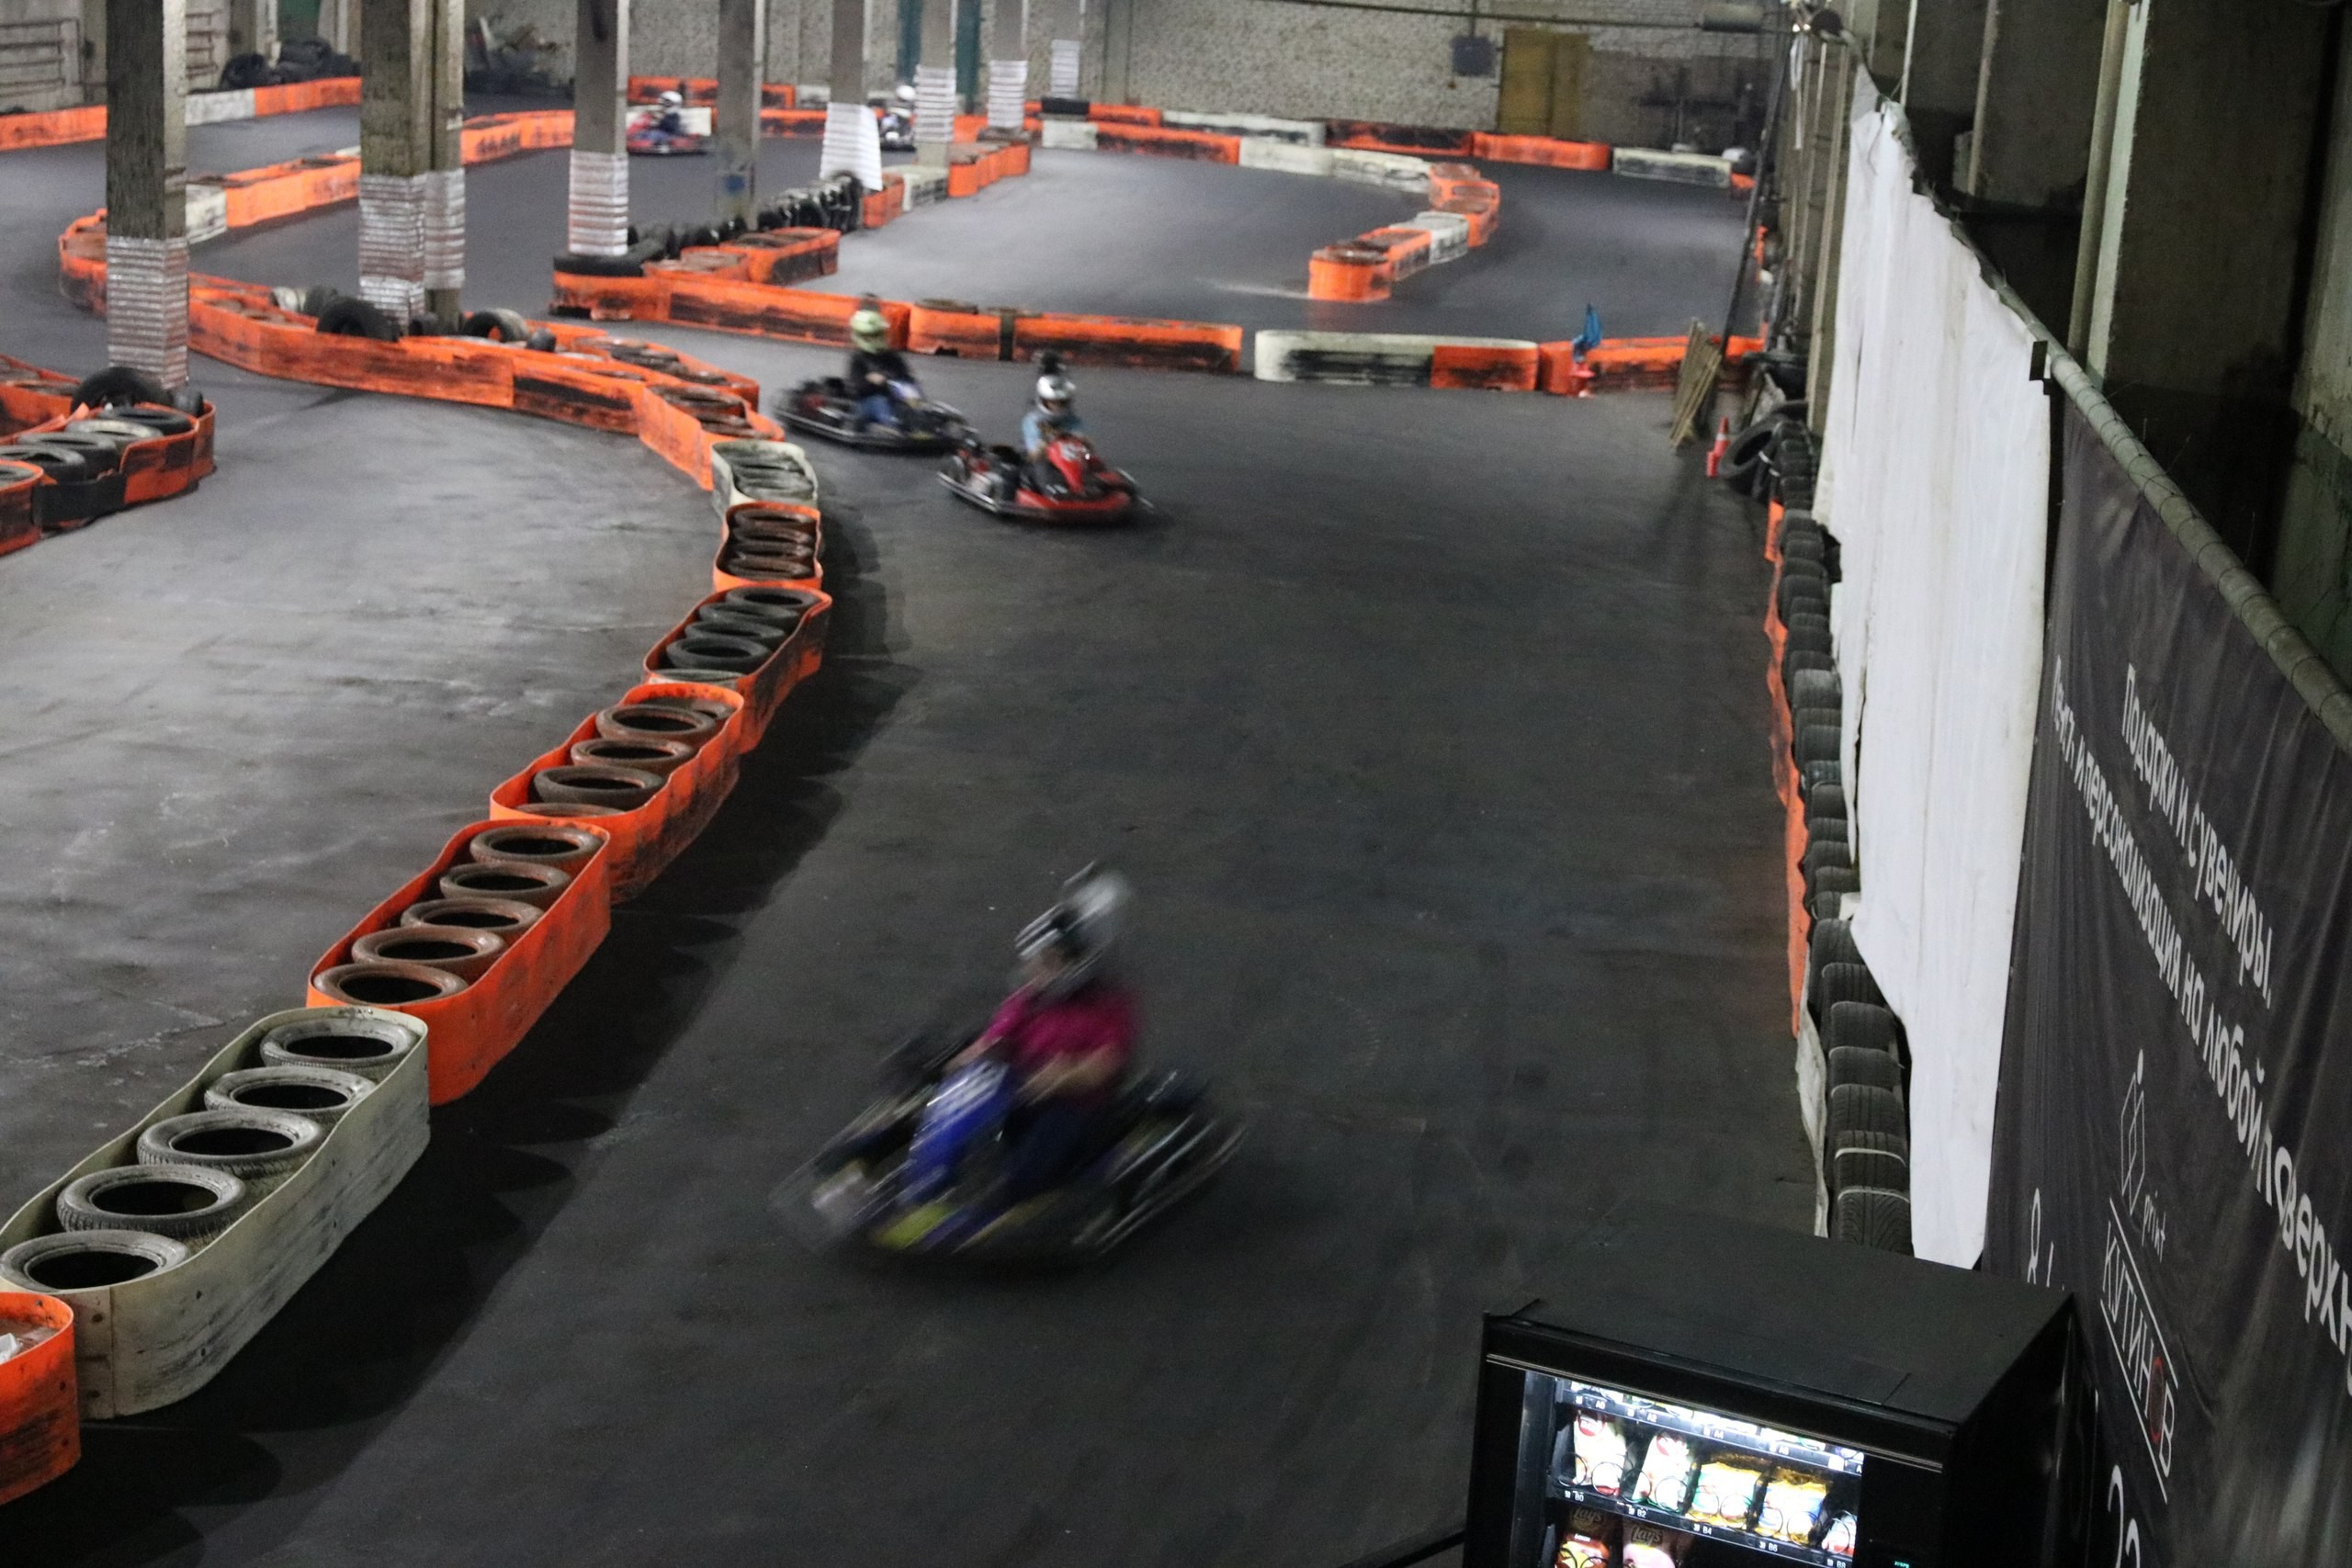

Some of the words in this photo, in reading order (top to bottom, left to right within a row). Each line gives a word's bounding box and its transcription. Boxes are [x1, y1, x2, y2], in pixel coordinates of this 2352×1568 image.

[2122, 662, 2178, 827] Подарки
[2176, 777, 2188, 849] и
[2074, 735, 2086, 792] и
[2083, 750, 2182, 1000] персонализация
[2181, 952, 2204, 1046] на
[2203, 1002, 2266, 1171] любой
[2102, 1220, 2176, 1478] КУТИНОВ
[1636, 1508, 1647, 1518] B2
[1702, 1525, 1713, 1535] B4
[1768, 1542, 1779, 1552] B6
